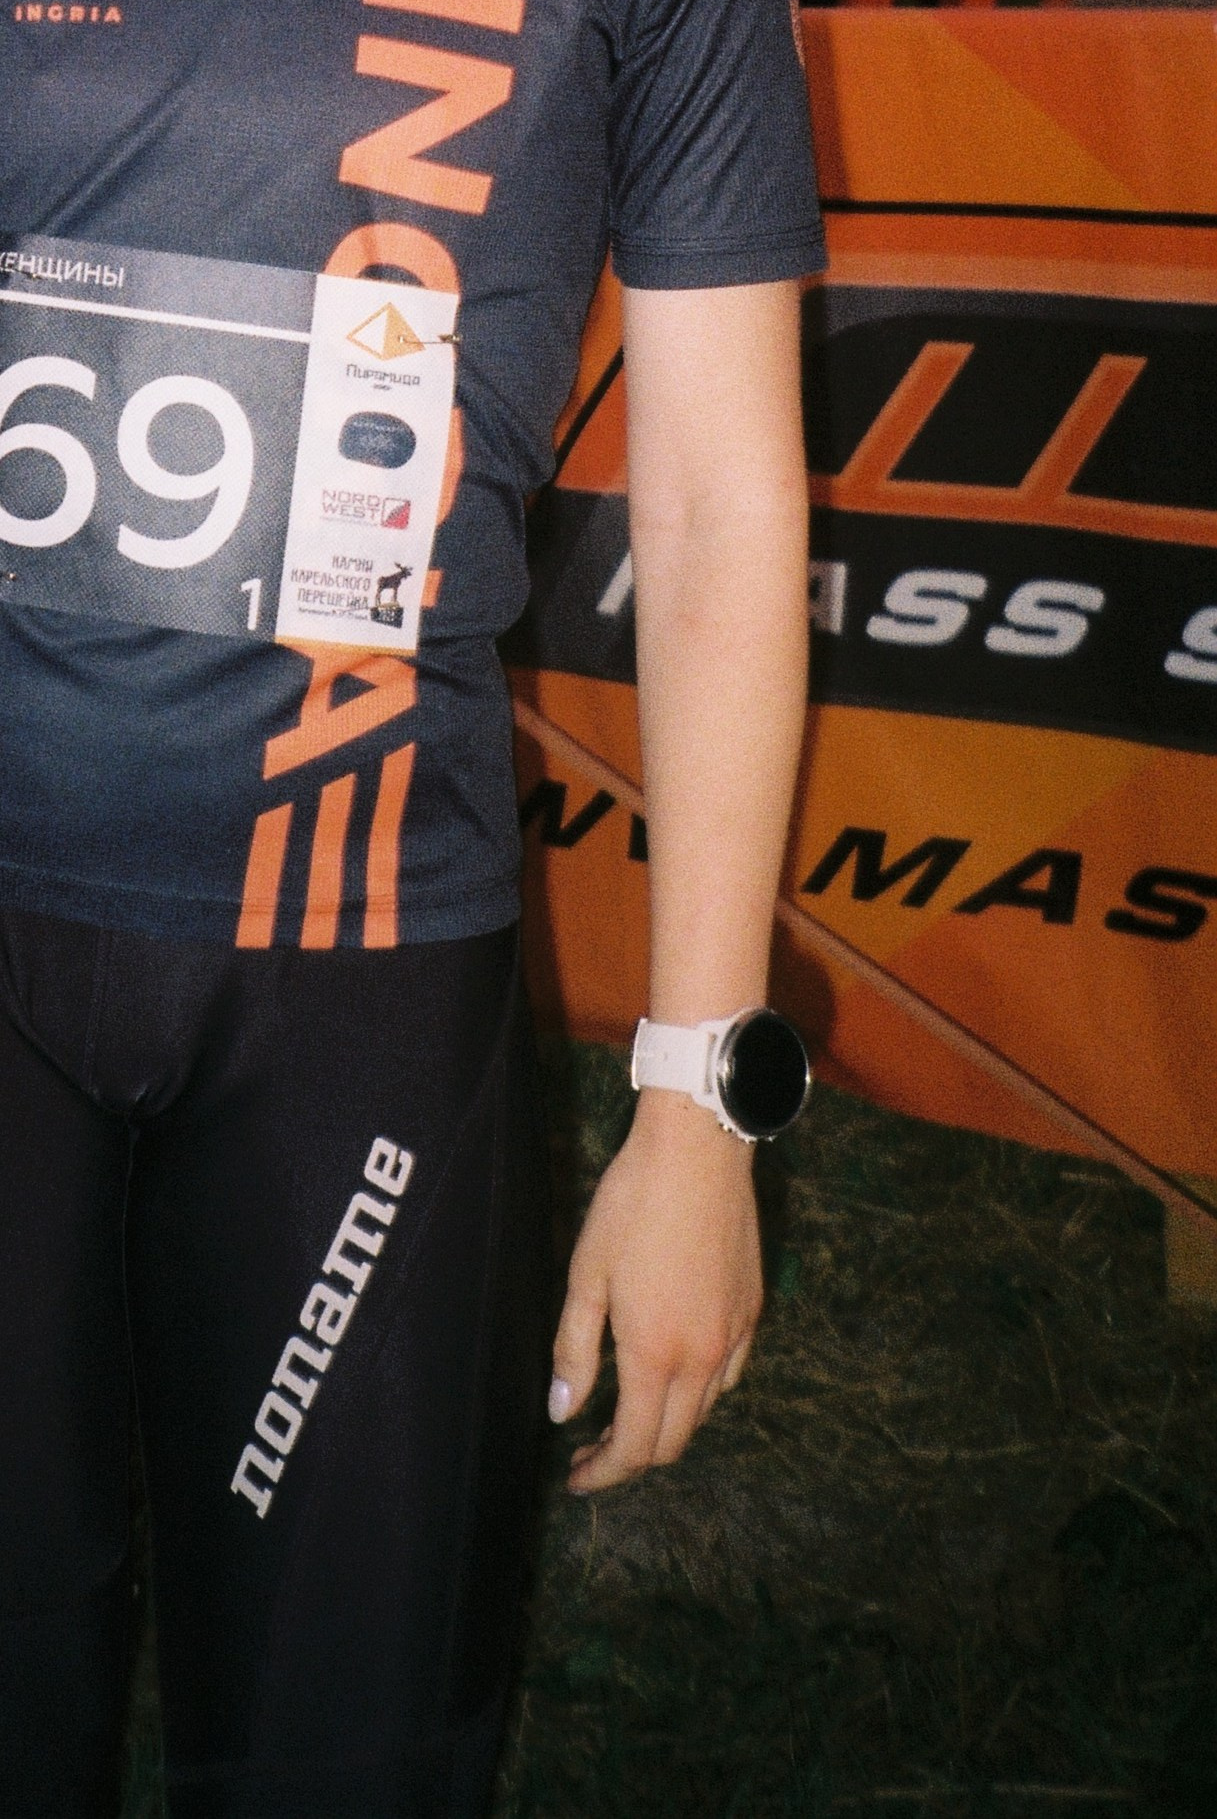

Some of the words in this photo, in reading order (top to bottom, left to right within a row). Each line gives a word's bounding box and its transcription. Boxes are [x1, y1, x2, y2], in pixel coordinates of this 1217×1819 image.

[322, 489, 381, 508] NORD
[322, 501, 380, 520] WEST
[331, 555, 374, 573] КАМНИ
[290, 568, 372, 592] КАРЕЛЬСКОГО
[240, 577, 263, 632] 1
[297, 587, 370, 611] ПЕРЕШЕЙКА
[230, 1136, 415, 1520] noname
